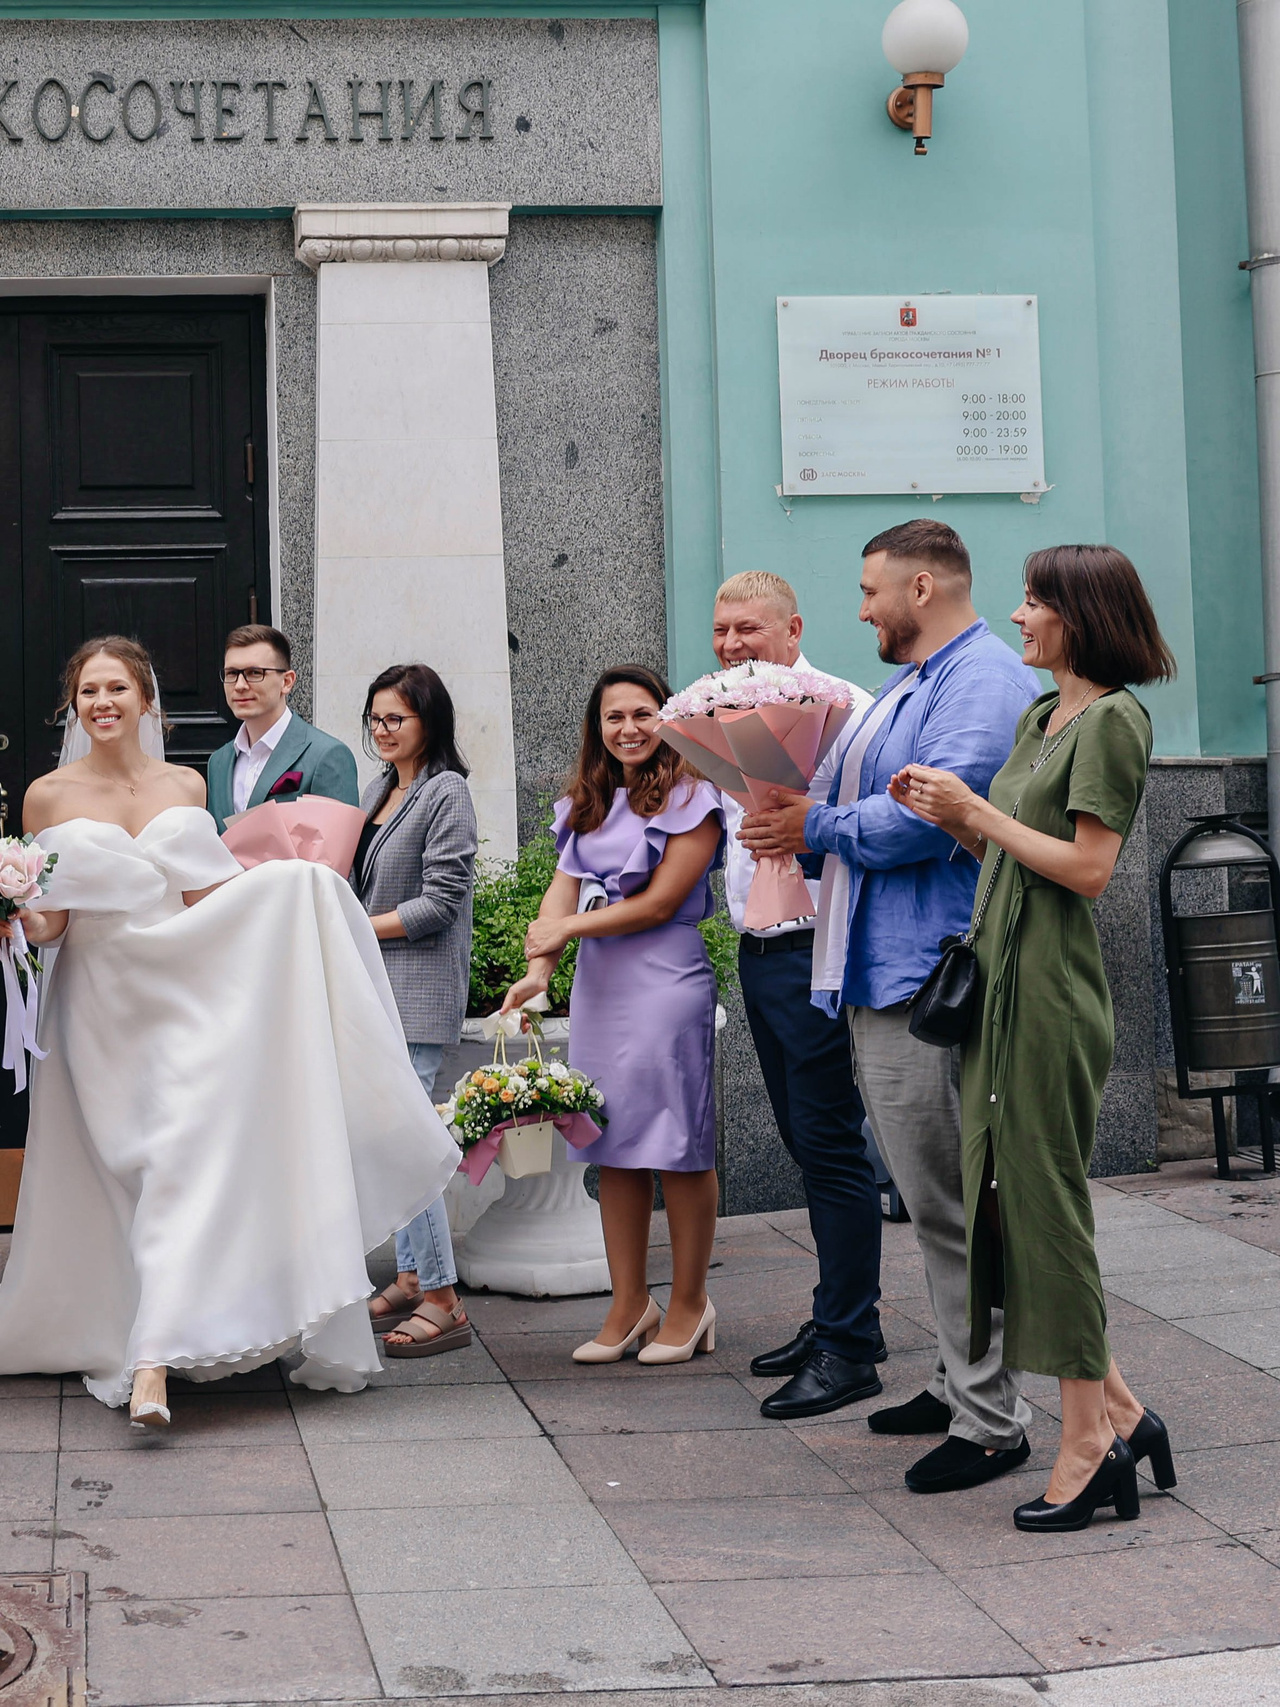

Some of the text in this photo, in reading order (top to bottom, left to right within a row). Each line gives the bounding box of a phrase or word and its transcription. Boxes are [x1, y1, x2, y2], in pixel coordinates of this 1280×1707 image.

[819, 348, 1001, 362] Дворец бракосочетания № 1
[867, 378, 955, 388] РЕЖИМ РАБОТЫ
[962, 394, 986, 404] 9:00
[997, 393, 1026, 404] 18:00
[962, 411, 987, 421] 9:00
[996, 411, 1026, 420] 20:00
[963, 428, 987, 438] 9:00
[996, 428, 1027, 438] 23:59
[957, 445, 988, 455] 00:00
[999, 445, 1027, 455] 19:00
